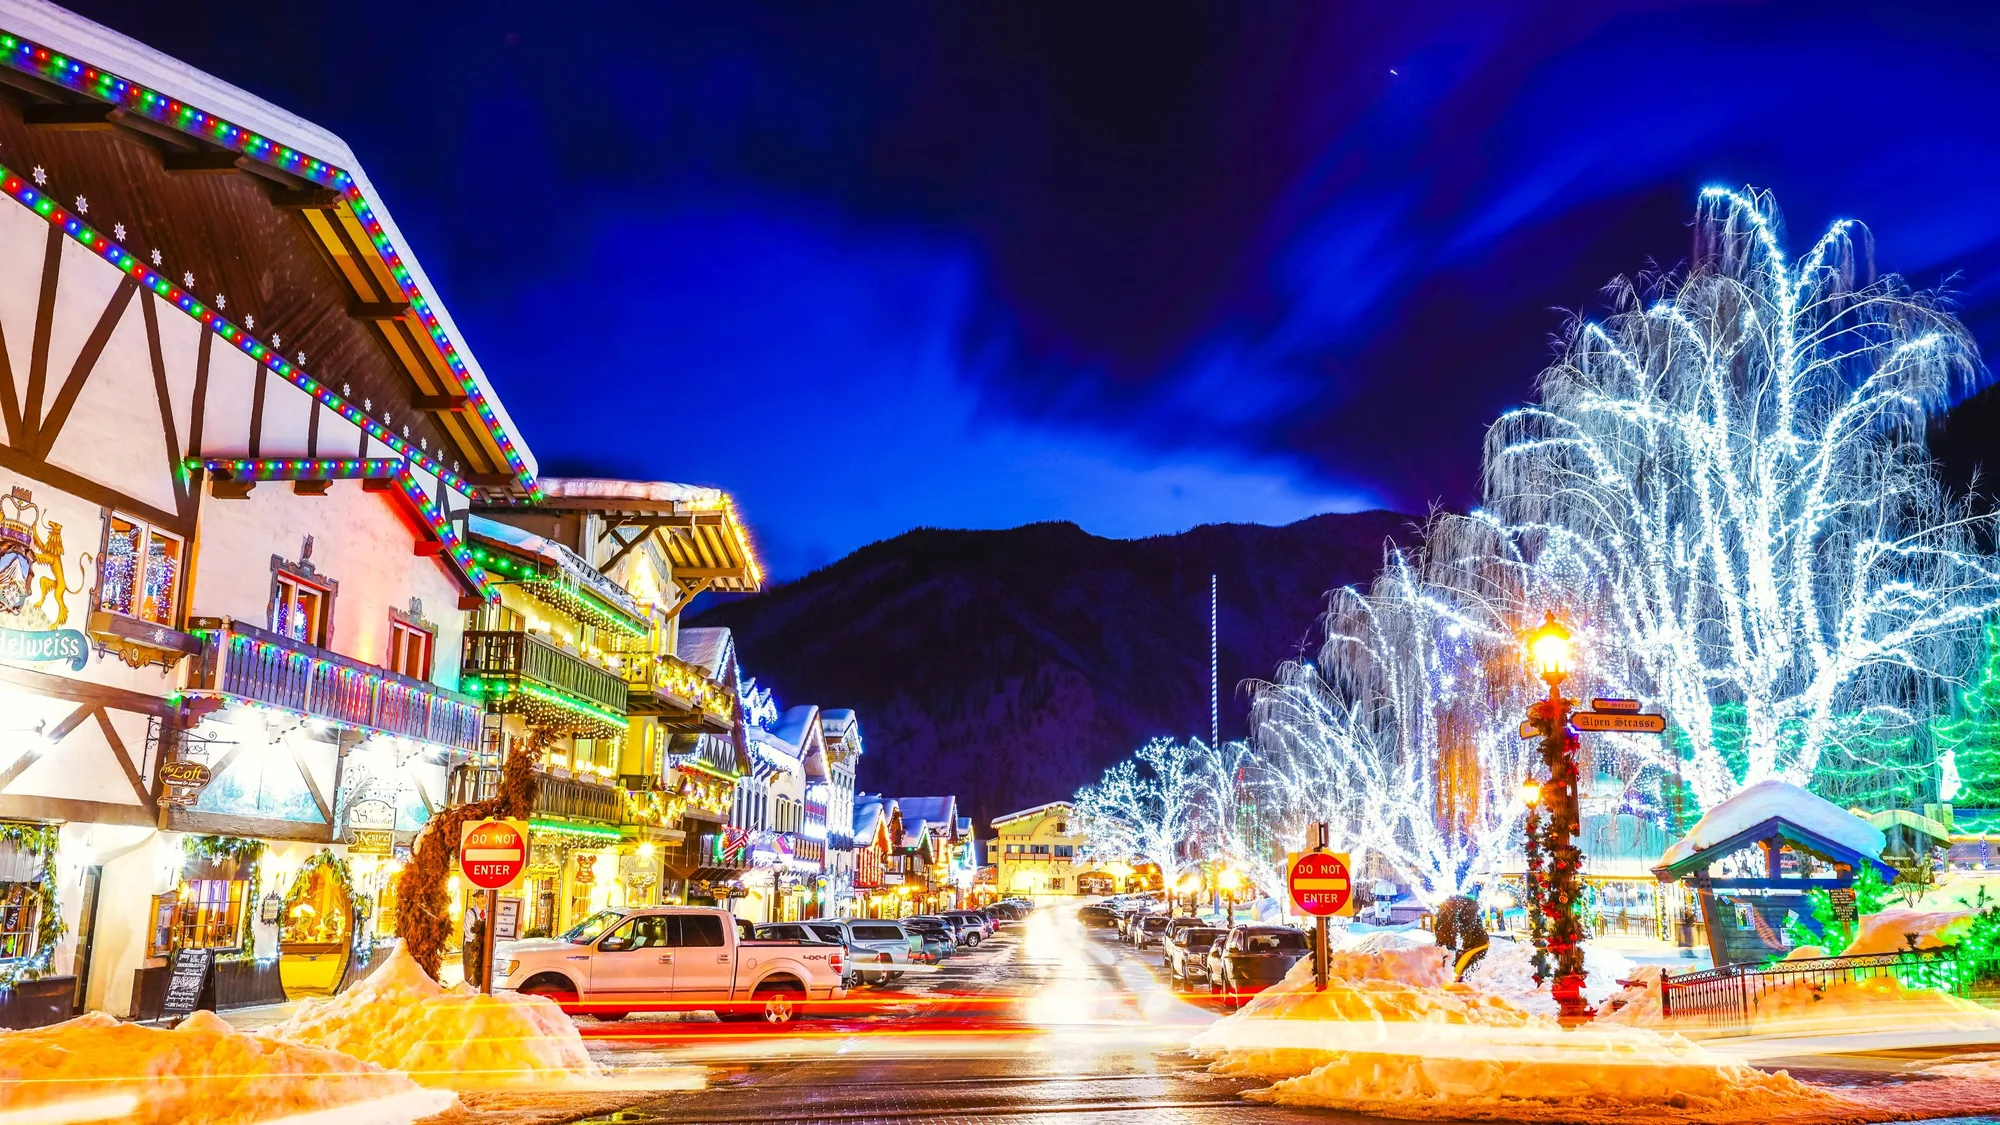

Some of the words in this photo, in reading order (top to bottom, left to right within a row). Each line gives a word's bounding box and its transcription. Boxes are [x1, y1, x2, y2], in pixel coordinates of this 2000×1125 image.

[1582, 716, 1610, 727] Alpen
[1614, 717, 1655, 728] Strasse
[168, 765, 202, 781] Loft
[360, 831, 391, 847] Kestrel
[472, 834, 487, 845] DO
[495, 834, 516, 845] NOT
[473, 864, 510, 876] ENTER
[1298, 864, 1314, 875] DO
[1320, 864, 1341, 875] NOT
[1303, 893, 1338, 904] ENTER
